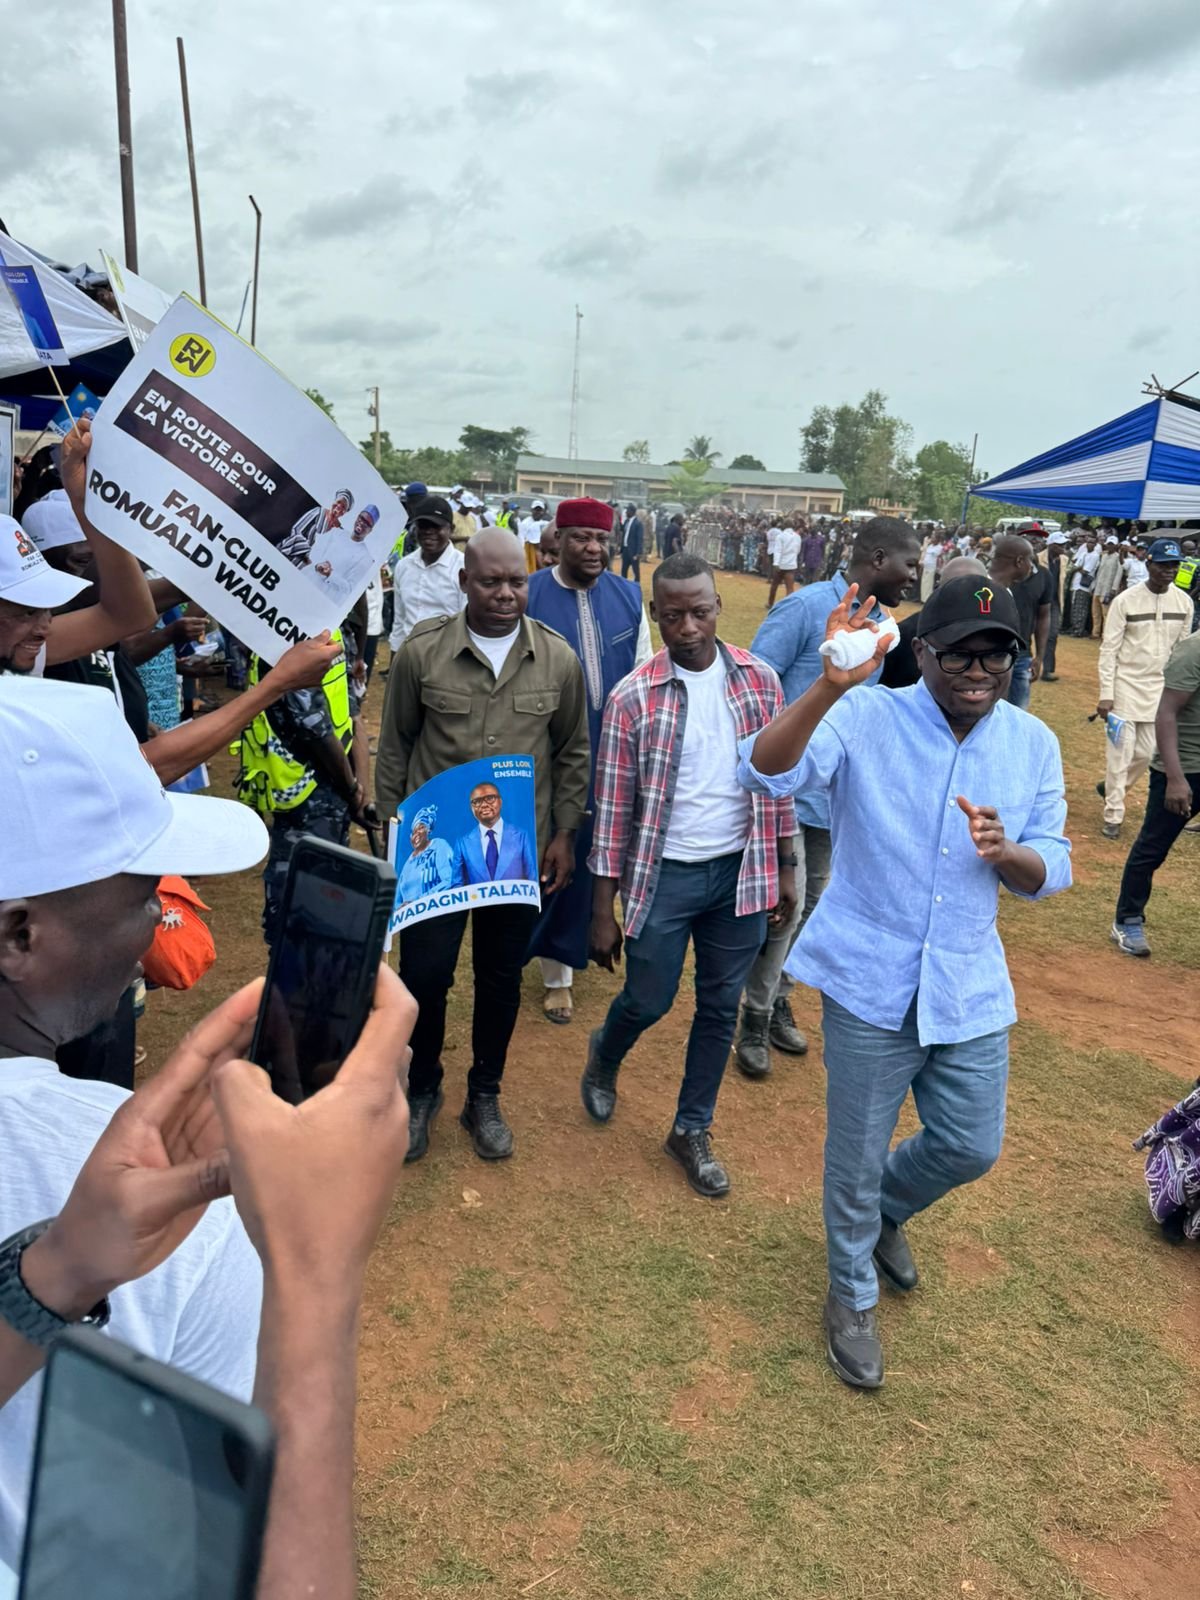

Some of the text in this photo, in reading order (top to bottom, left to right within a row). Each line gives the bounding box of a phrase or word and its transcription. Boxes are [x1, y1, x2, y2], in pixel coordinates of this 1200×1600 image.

[133, 402, 249, 495] LA VICTOIRE...
[144, 388, 277, 496] EN ROUTE POUR
[88, 468, 313, 646] ROMUALD WADAGN
[162, 489, 281, 591] FAN-CLUB
[492, 760, 513, 769] PLUS
[389, 884, 538, 932] WADAGNI TALATA
